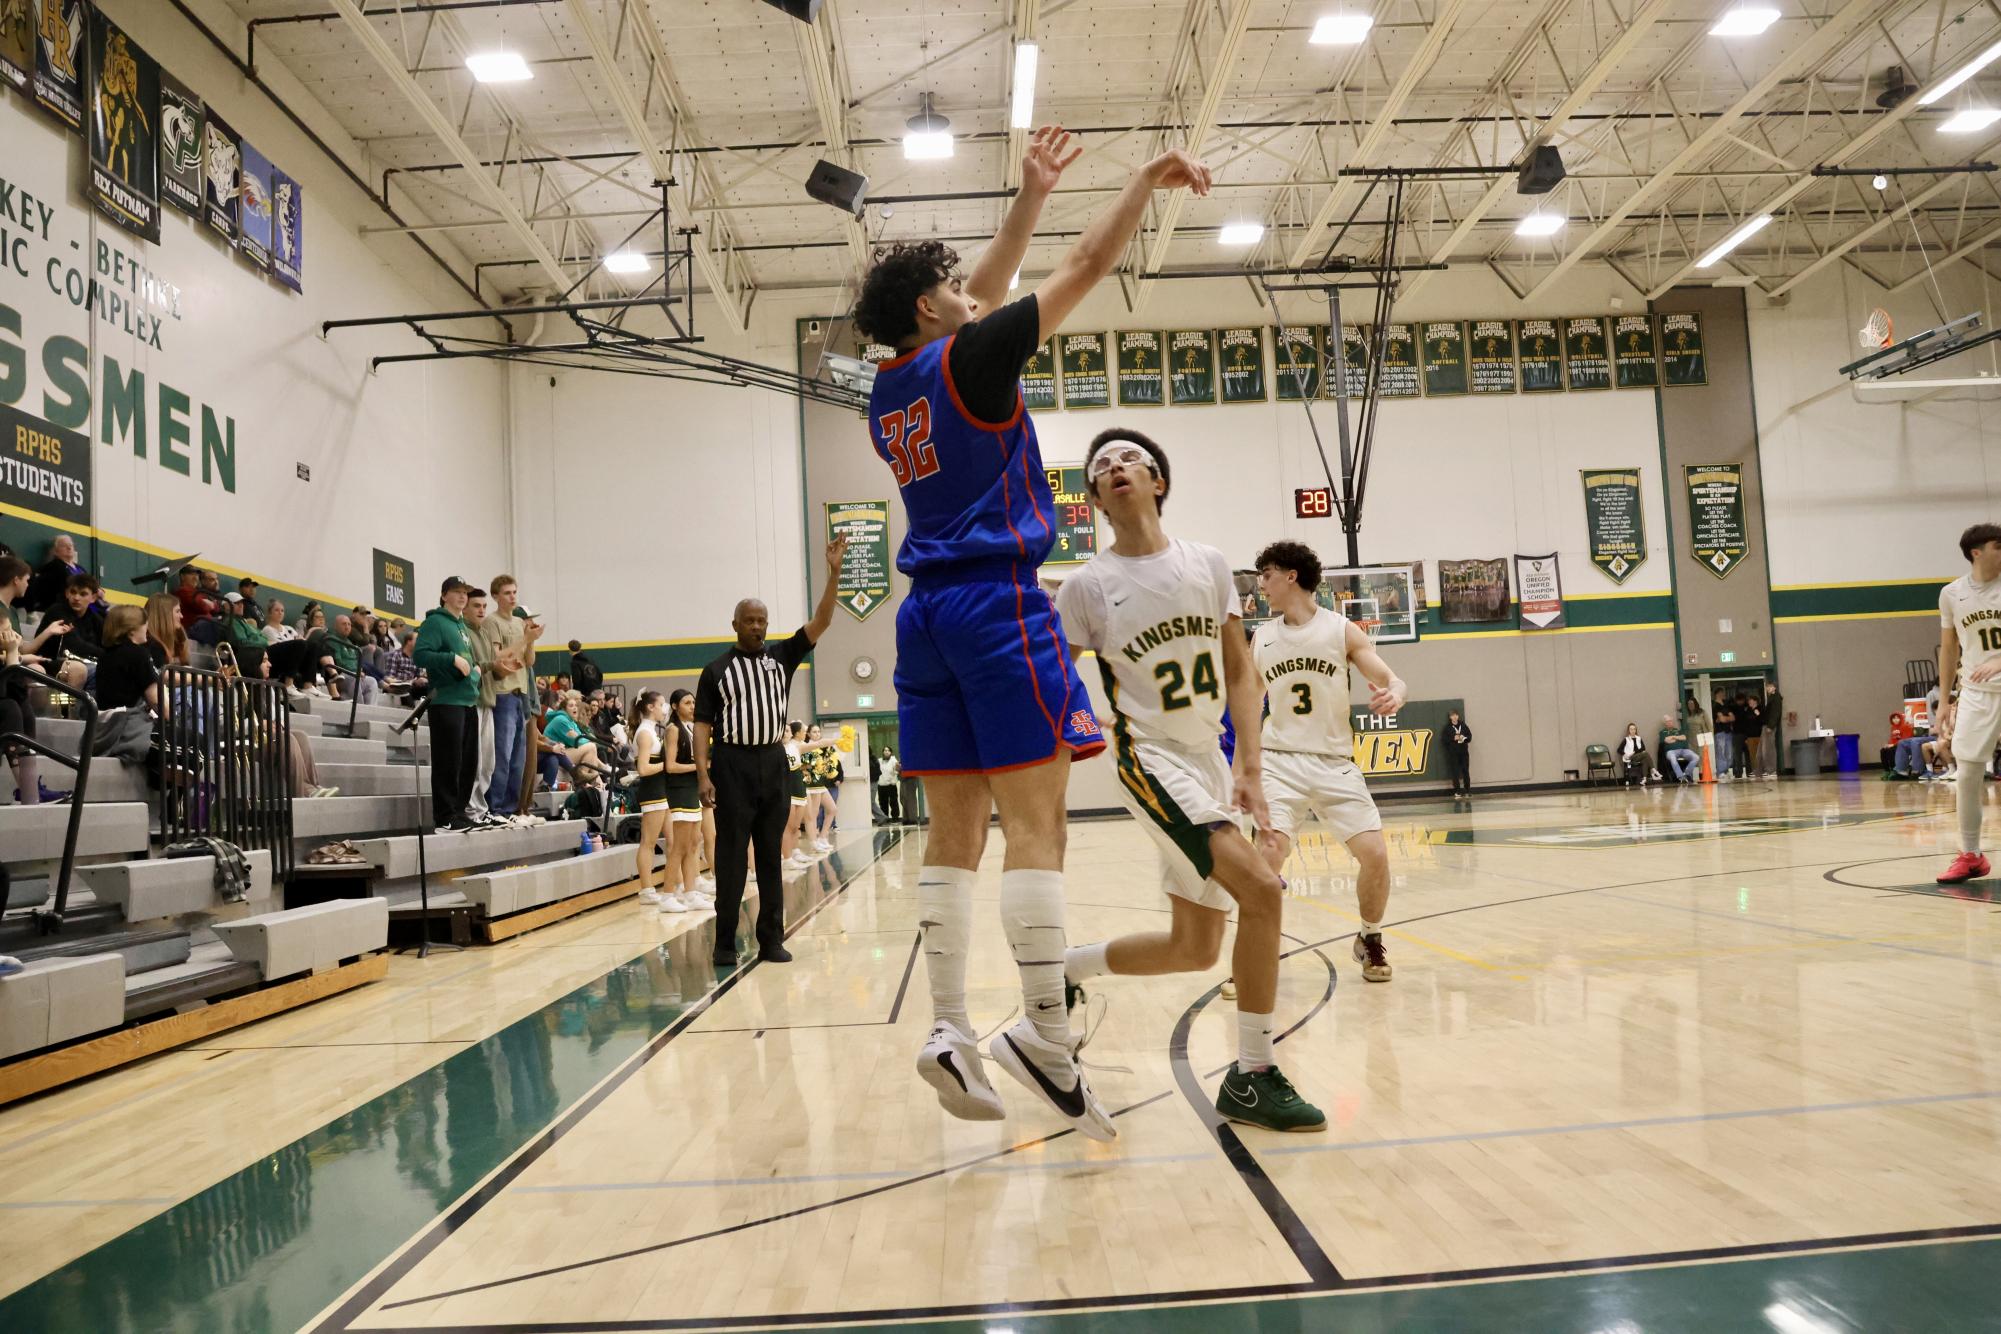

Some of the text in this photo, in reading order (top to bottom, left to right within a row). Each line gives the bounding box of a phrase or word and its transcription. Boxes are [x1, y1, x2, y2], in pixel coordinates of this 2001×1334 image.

[94, 168, 111, 196] REX
[112, 182, 150, 223] PUTNAM
[164, 175, 199, 208] PARKROSE
[46, 256, 163, 352] COMPLEX
[1668, 315, 1692, 323] LEAGUE
[1226, 330, 1253, 338] LEAGUE
[1522, 329, 1555, 339] CHAMPIONS
[1569, 327, 1601, 337] CHAMPIONS
[1616, 324, 1649, 335] CHAMPIONS
[1665, 322, 1697, 333] CHAMPIONS
[1068, 335, 1096, 344] LEAGUE
[1426, 331, 1459, 342] CHAMPIONS
[1474, 330, 1507, 340] CHAMPIONS
[1065, 342, 1101, 355] CHAMPIONS
[1123, 340, 1157, 351] CHAMPIONS
[1173, 340, 1207, 350] CHAMPIONS
[1223, 337, 1257, 348] CHAMPIONS
[15, 424, 62, 465] RPHS
[879, 396, 940, 488] 32
[1053, 493, 1086, 504] ASALLE
[1302, 491, 1328, 513] 28
[1066, 505, 1091, 525] 39
[1074, 526, 1094, 534] FOULS
[1087, 535, 1092, 549] 1
[385, 561, 403, 584] RPHS
[386, 583, 404, 606] FANS
[1121, 615, 1218, 664] KINGSME
[1978, 627, 2001, 652] 10
[1265, 657, 1337, 684] KINGSMEN
[1153, 650, 1219, 712] 24
[1291, 683, 1313, 715] 3
[1356, 713, 1398, 730] THE
